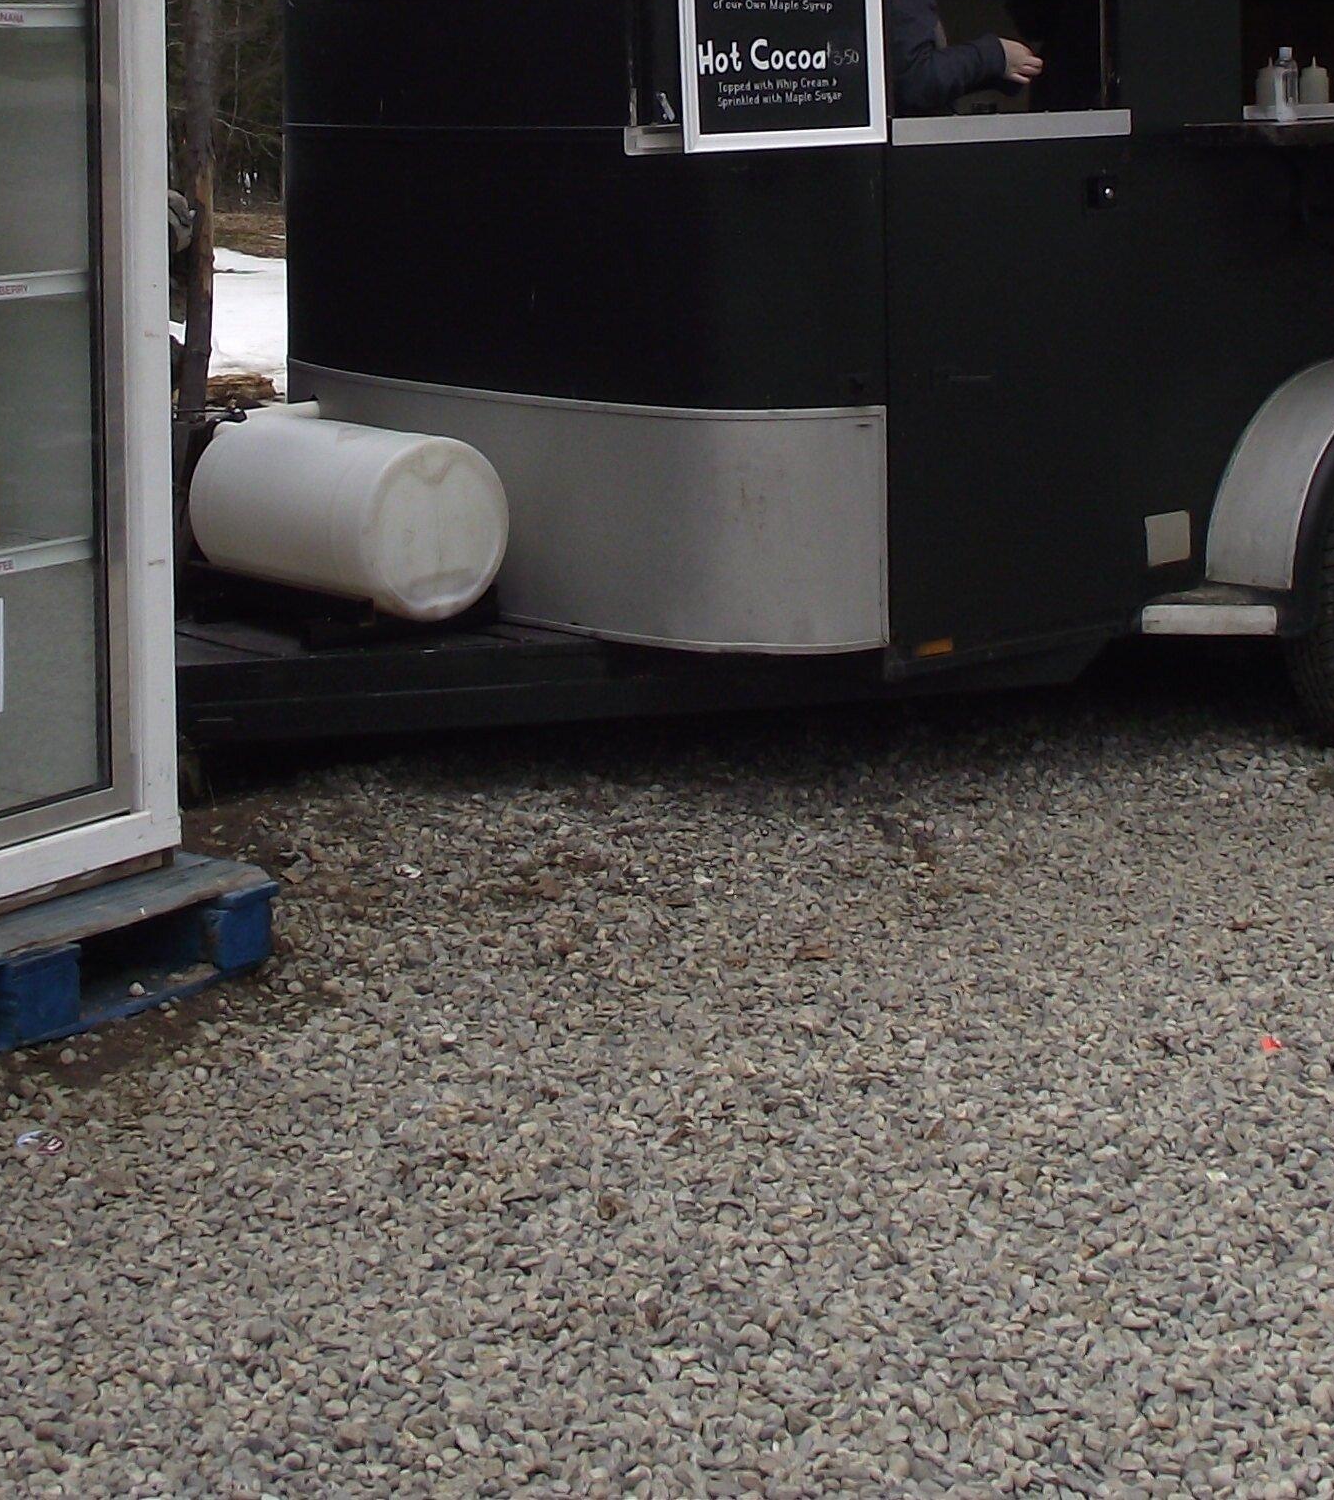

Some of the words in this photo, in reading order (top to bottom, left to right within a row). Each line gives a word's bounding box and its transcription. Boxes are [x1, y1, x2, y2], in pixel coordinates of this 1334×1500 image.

[713, 0, 723, 9] of
[725, 1, 743, 10] our
[745, 0, 767, 10] Own
[769, 0, 799, 13] Maple
[802, 0, 833, 13] Syrup
[698, 39, 743, 75] Hot
[750, 38, 828, 71] Cocoa
[718, 81, 751, 95] Topped
[753, 80, 774, 90] with
[776, 79, 799, 91] Whip
[800, 77, 829, 88] Cream
[717, 95, 760, 110] Sprinkled
[762, 93, 783, 103] with
[785, 91, 812, 106] Maple
[815, 90, 843, 104] Sugar
